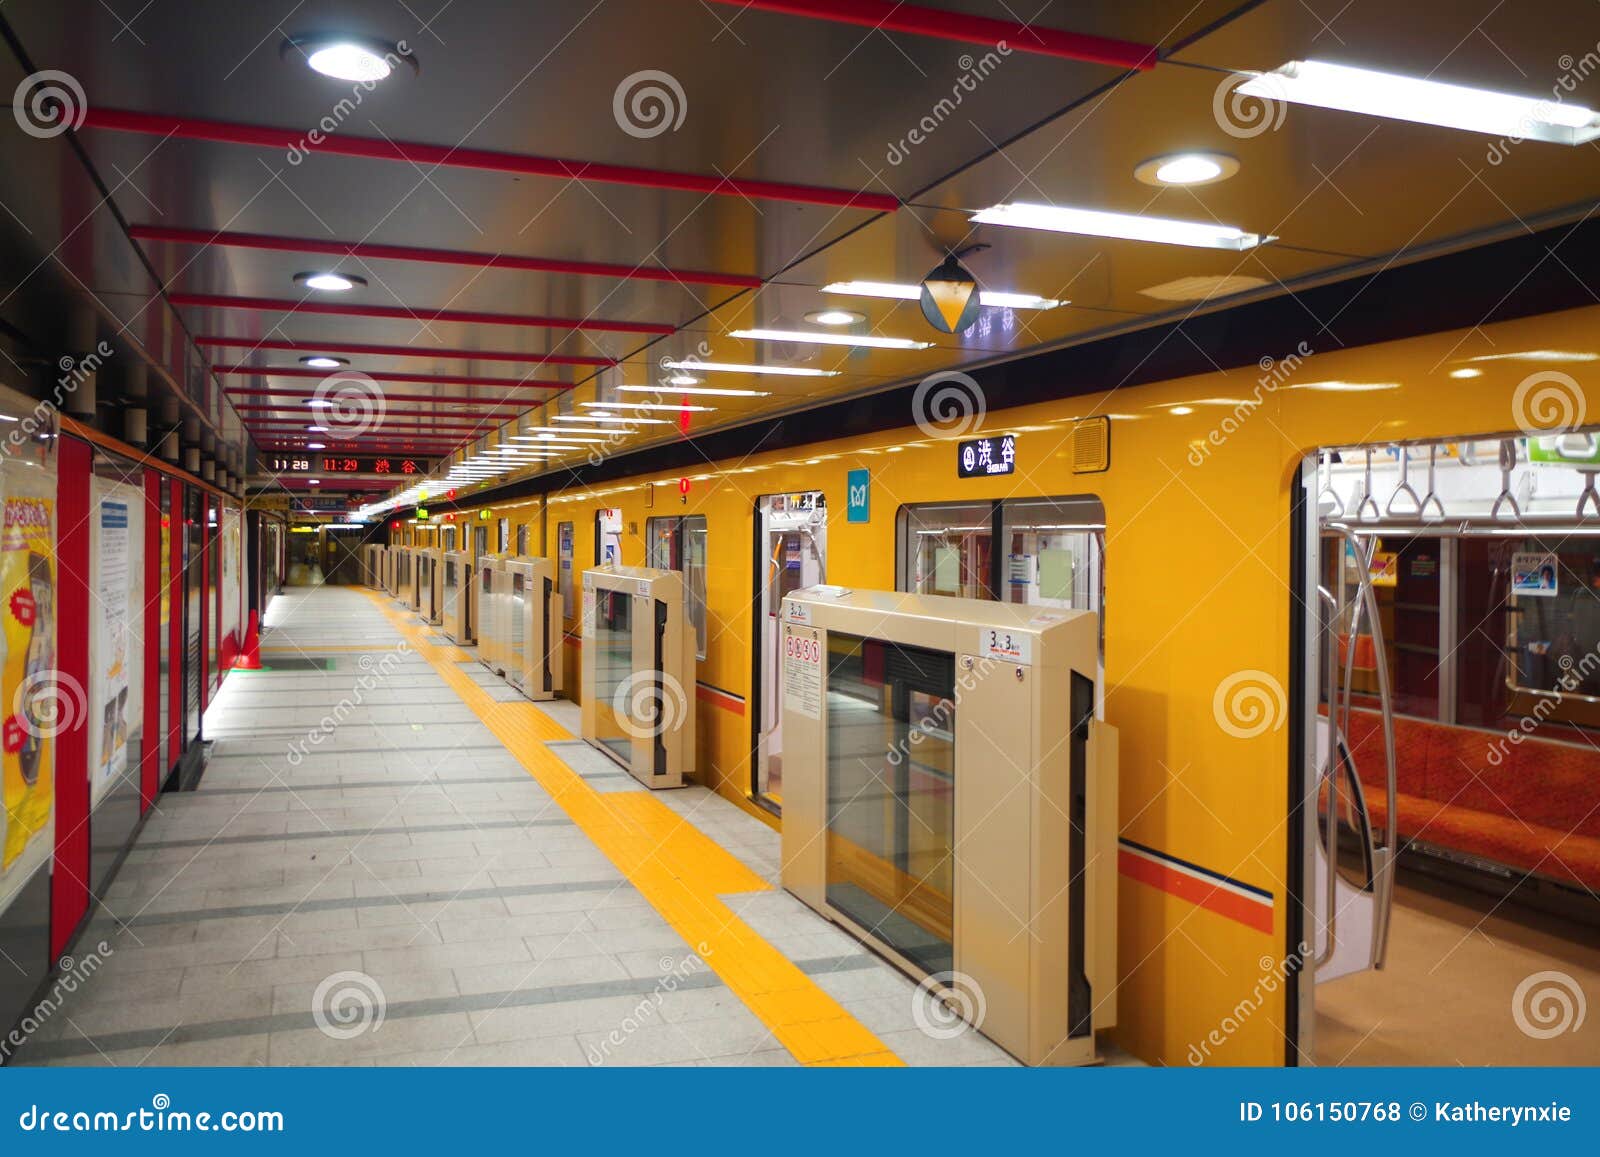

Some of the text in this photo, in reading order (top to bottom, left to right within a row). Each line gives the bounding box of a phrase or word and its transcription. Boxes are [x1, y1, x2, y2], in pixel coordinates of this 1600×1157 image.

[978, 438, 1014, 466] 渋谷
[274, 459, 309, 470] 11 28
[323, 459, 358, 471] 11:29
